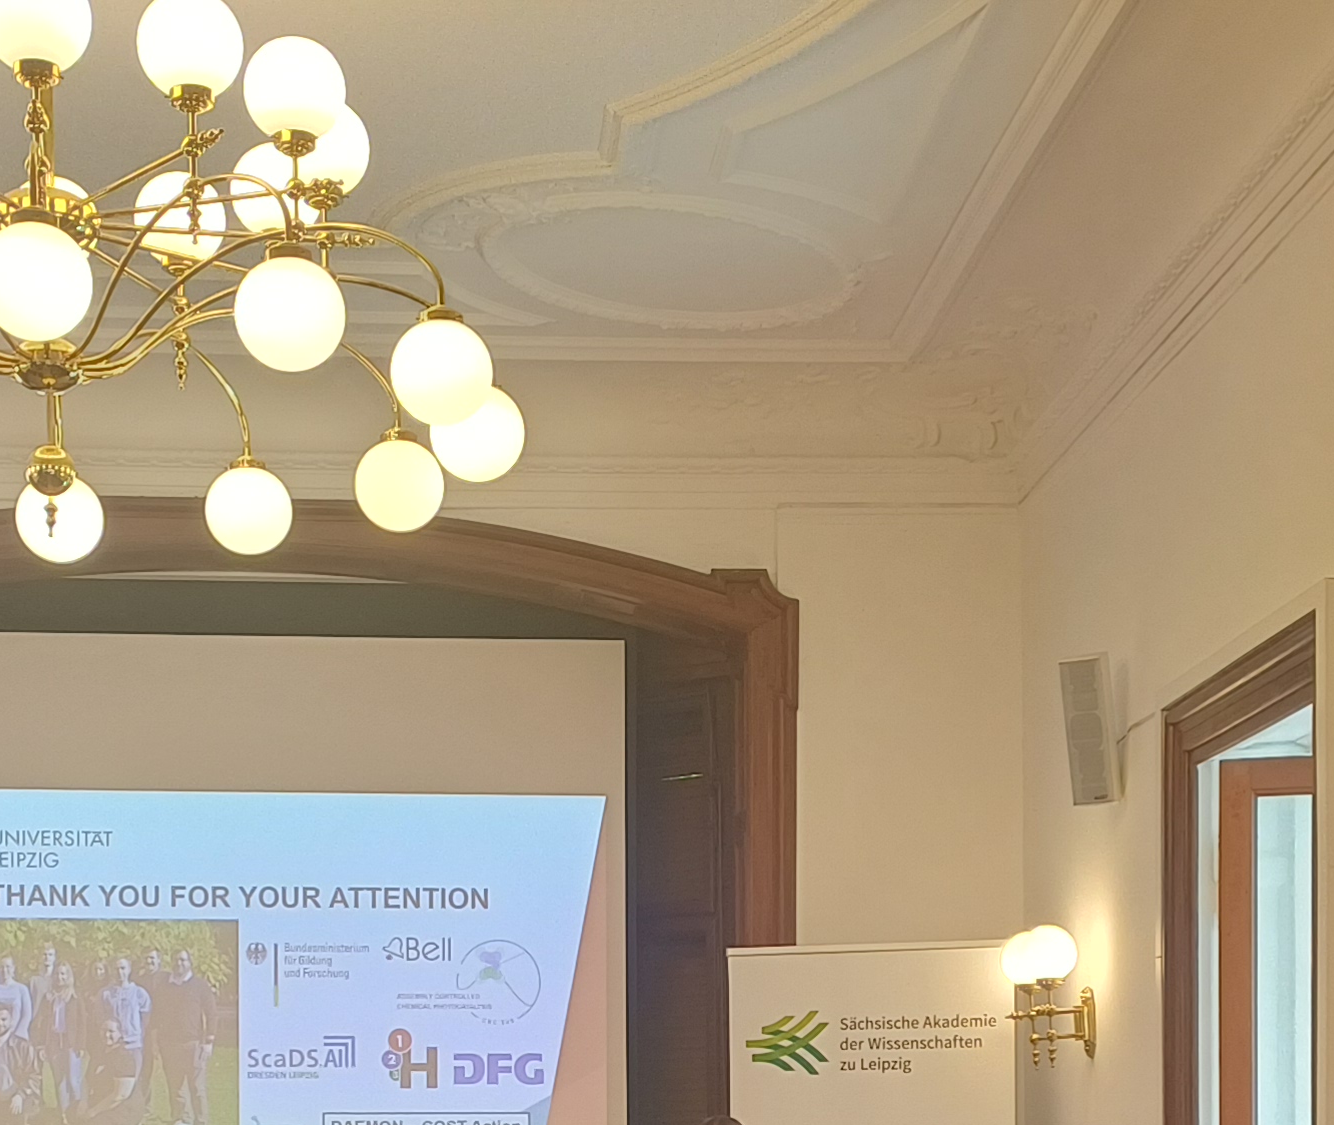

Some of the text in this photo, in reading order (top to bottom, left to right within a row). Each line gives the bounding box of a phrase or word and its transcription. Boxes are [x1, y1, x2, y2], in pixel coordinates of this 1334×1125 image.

[98, 885, 160, 908] YOU
[170, 885, 231, 908] FOR
[238, 886, 322, 909] YOUR
[329, 886, 489, 910] ATTENTION
[284, 942, 370, 953] Bundesministerium
[405, 936, 453, 962] Bell
[284, 955, 297, 965] für
[284, 967, 350, 980] und Forschung
[840, 1013, 997, 1031] Sächsische Akademie
[840, 1034, 983, 1051] der Wissenschaften
[453, 1053, 545, 1085] DFG
[840, 1057, 913, 1075] zu Leipzig
[247, 1071, 287, 1080] DRESDEN
